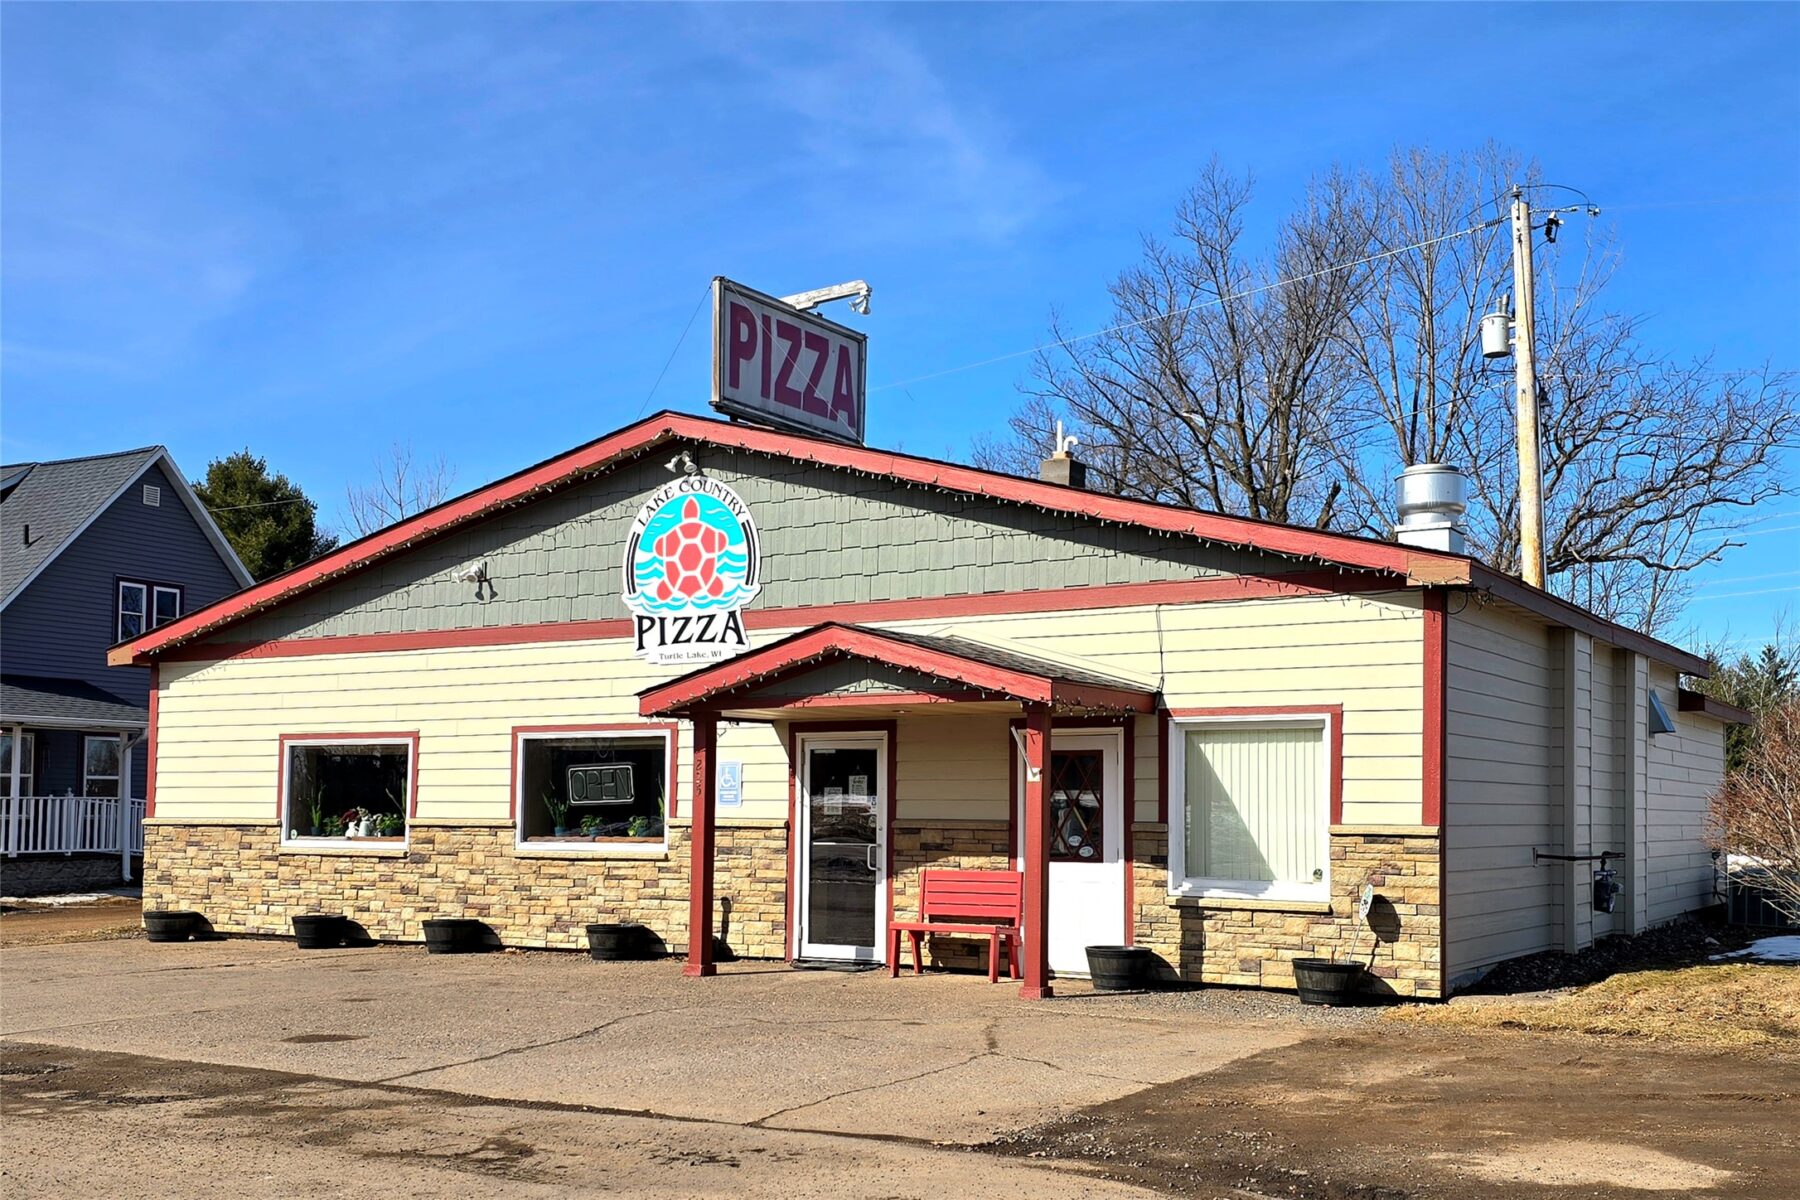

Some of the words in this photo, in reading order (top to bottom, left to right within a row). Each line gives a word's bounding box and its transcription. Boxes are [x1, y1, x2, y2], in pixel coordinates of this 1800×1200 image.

[729, 301, 856, 429] PIZZA
[638, 486, 675, 527] LAKE
[678, 478, 746, 517] COUNTRY
[635, 609, 746, 651] PIZZA
[659, 652, 683, 660] Turtle
[571, 768, 631, 801] OPEN
